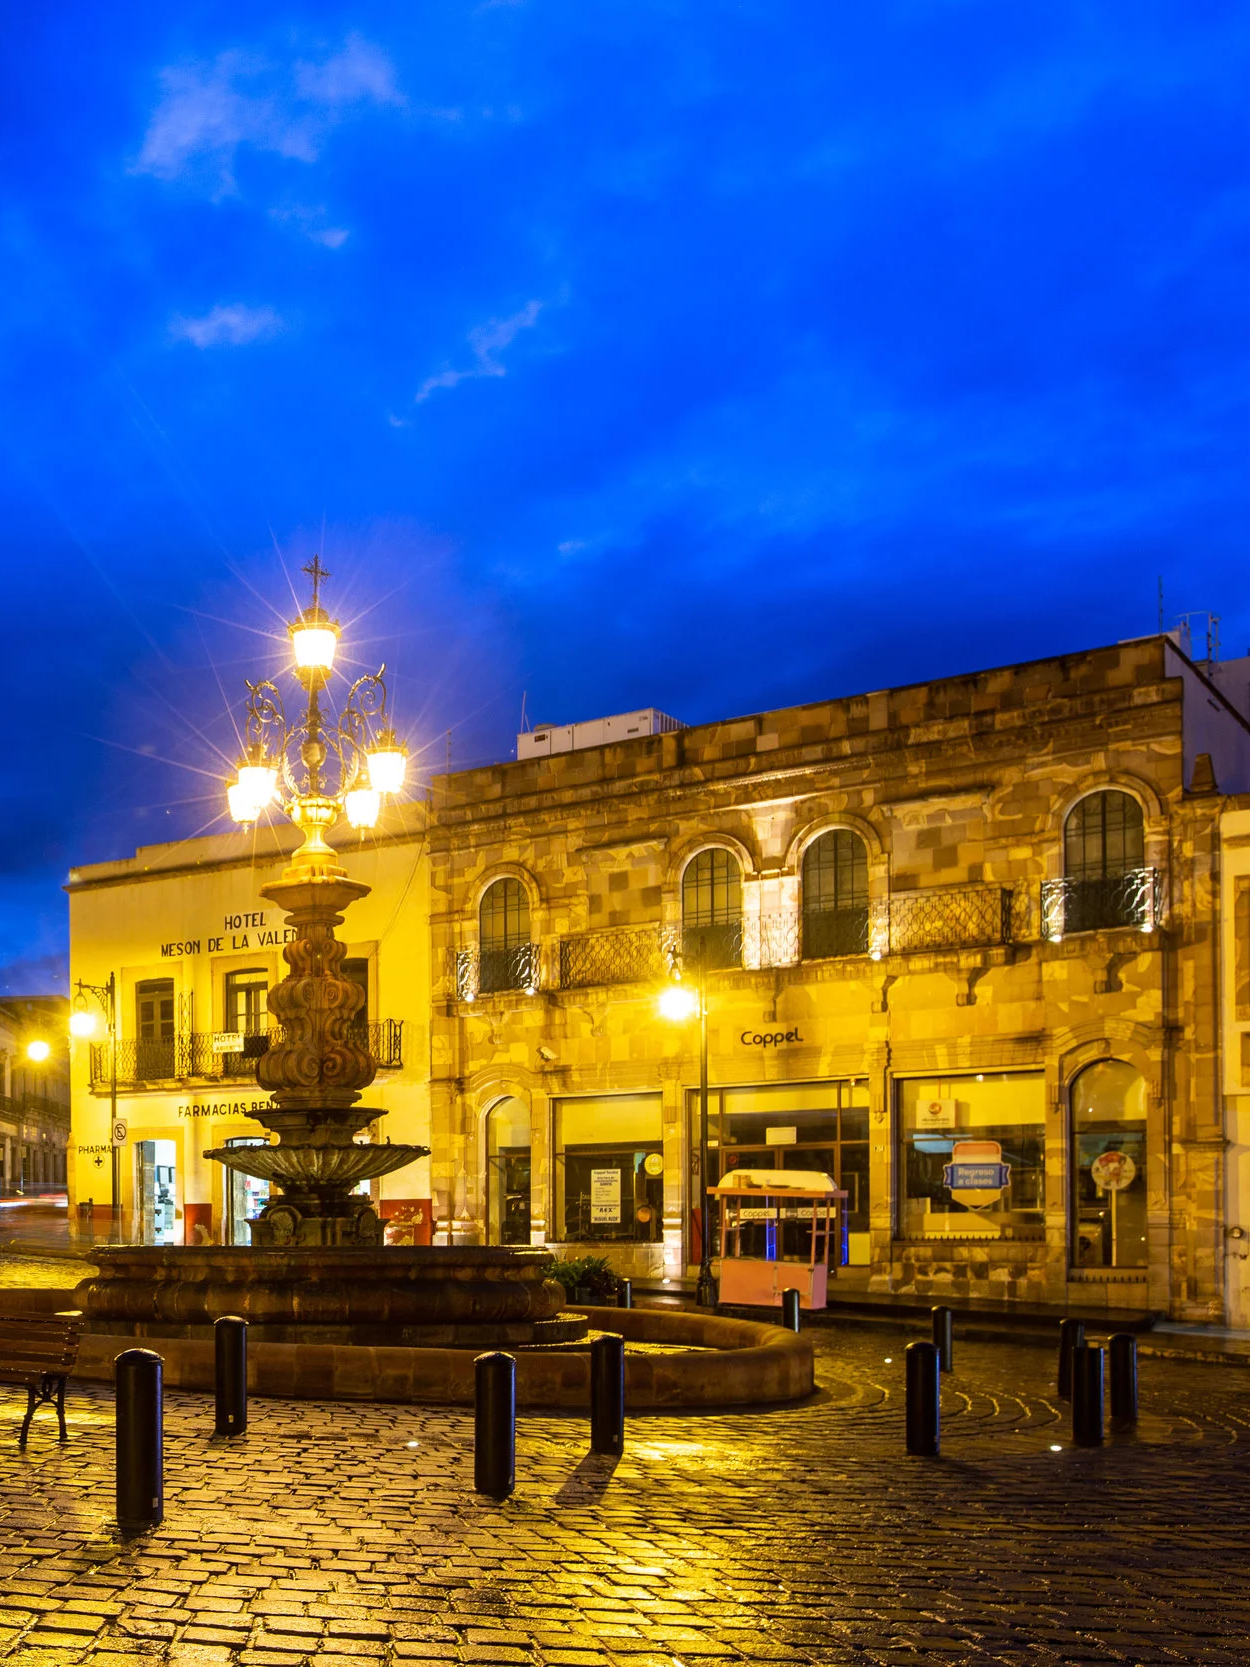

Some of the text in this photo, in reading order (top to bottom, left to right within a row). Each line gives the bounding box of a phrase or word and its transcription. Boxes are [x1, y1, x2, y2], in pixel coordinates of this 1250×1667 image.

[224, 911, 267, 930] HOTEL
[161, 940, 201, 957] MESON
[208, 937, 224, 952] DE
[232, 934, 249, 949] LA
[740, 1027, 804, 1048] Coppel
[178, 1102, 247, 1118] FARMACIAS
[957, 1167, 995, 1180] Regreso
